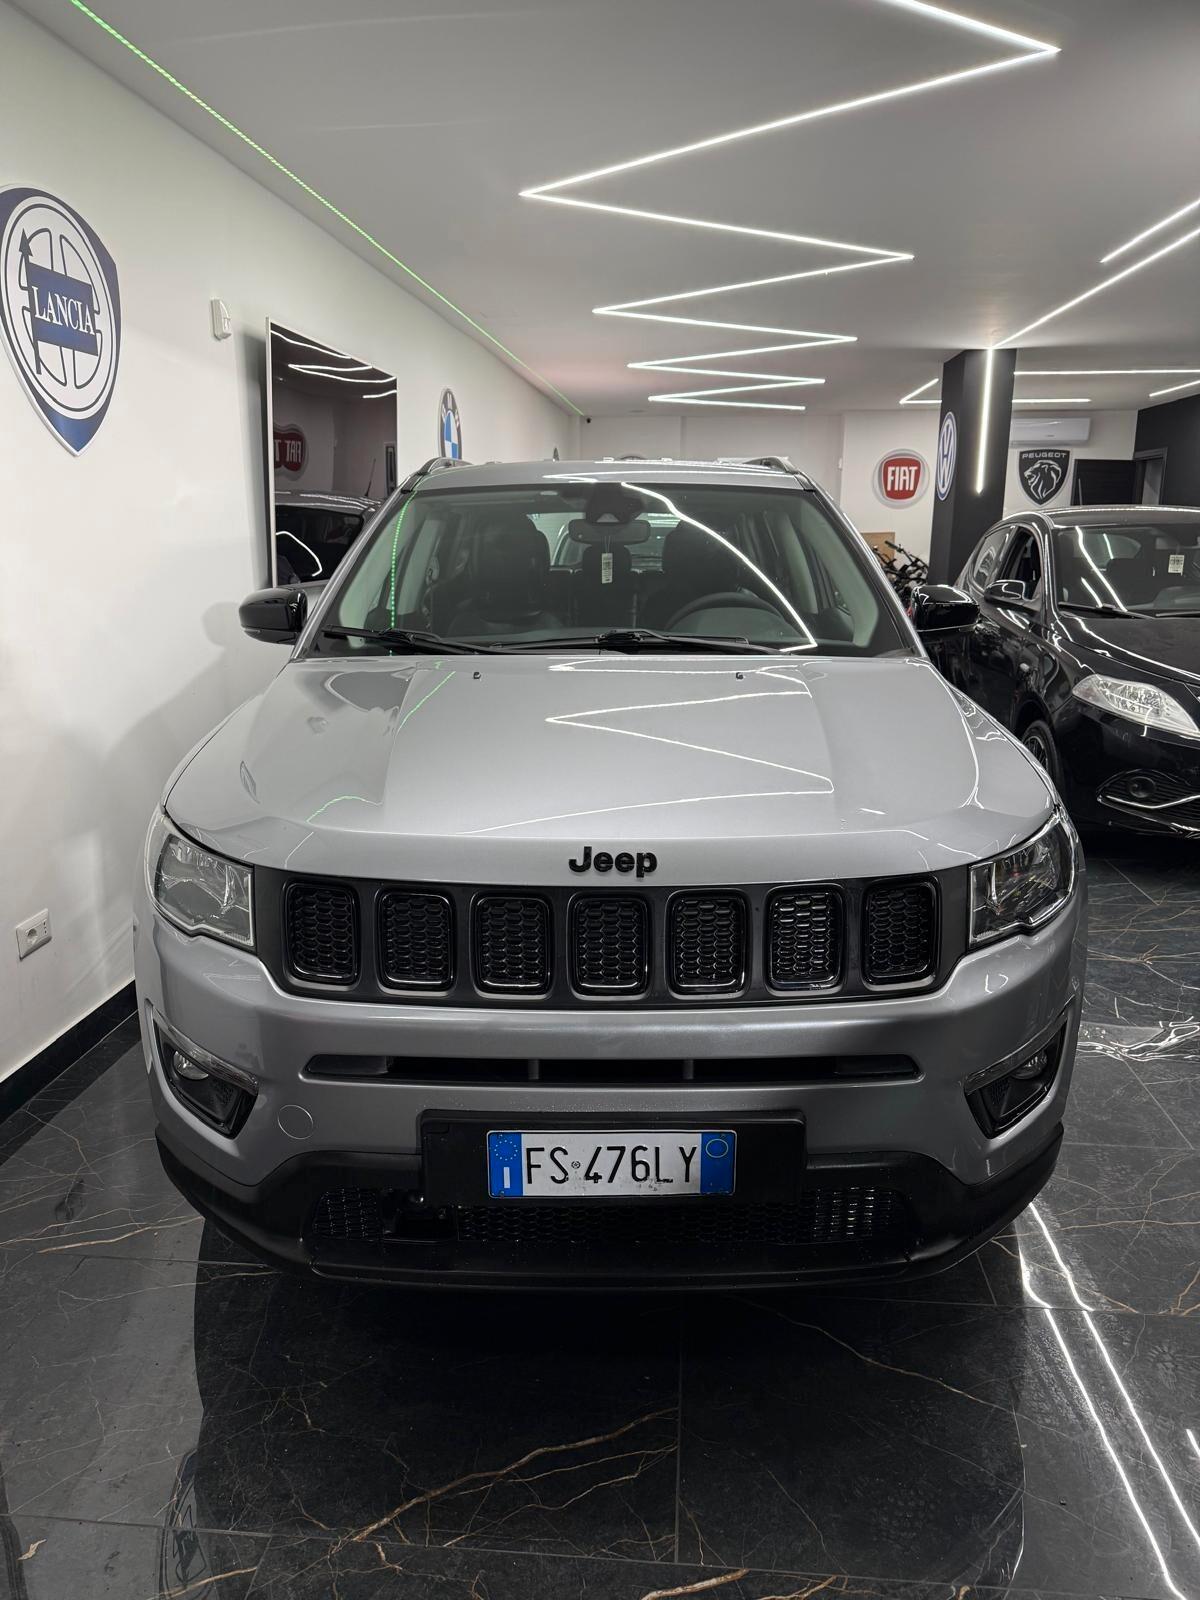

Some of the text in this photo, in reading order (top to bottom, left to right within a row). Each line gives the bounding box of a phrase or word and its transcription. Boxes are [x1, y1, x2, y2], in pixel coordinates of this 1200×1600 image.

[31, 286, 96, 336] LANCIA
[1022, 451, 1067, 459] PEUGEOT
[886, 466, 918, 491] FIAT
[568, 846, 658, 878] Jeep
